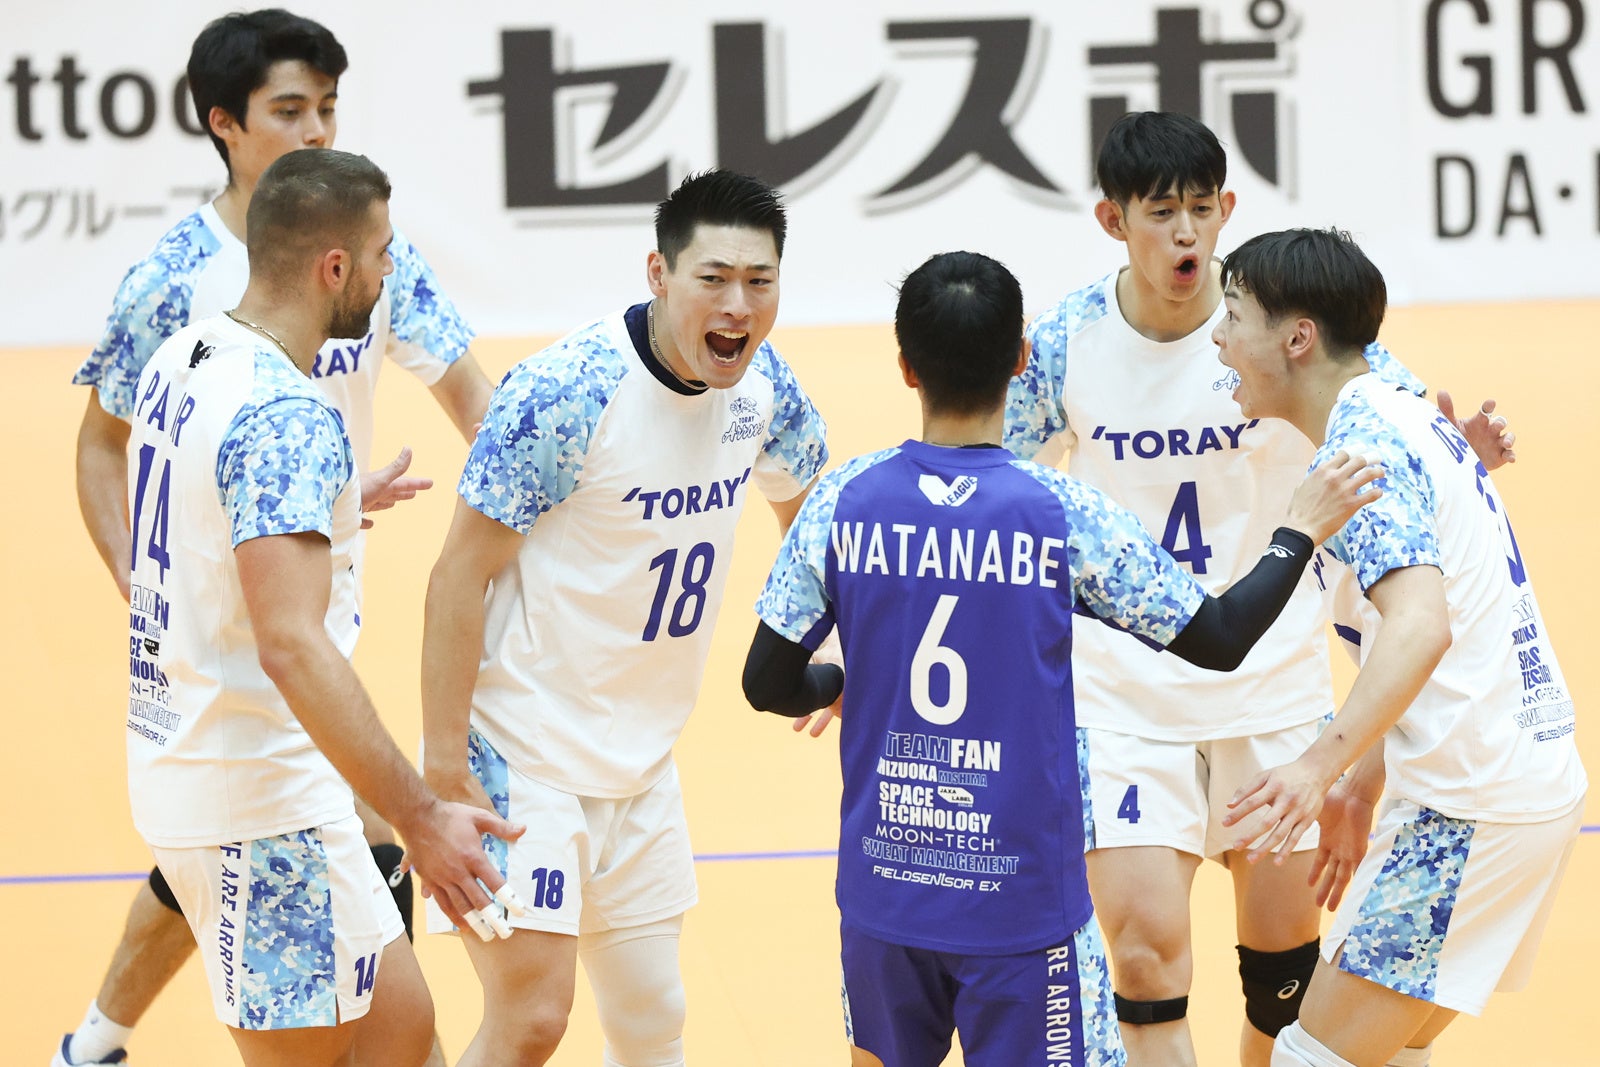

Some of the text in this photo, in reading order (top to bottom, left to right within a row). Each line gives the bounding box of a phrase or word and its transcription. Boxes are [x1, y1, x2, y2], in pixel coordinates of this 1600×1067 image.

[1425, 0, 1587, 117] GR
[467, 0, 1290, 212] セレスポ
[131, 443, 171, 585] 14
[941, 476, 978, 507] LEAGUE
[1160, 481, 1213, 574] 4
[831, 521, 1064, 588] WATANABE
[642, 541, 715, 642] 18
[910, 594, 968, 726] 6
[879, 781, 934, 807] SPACE
[938, 770, 987, 787] MISHIMA
[879, 801, 991, 834] TECHNOLOGY
[1117, 784, 1141, 824] 4
[862, 836, 1019, 874] SWEAT MANAGEMENT
[221, 864, 240, 911] ARE
[531, 867, 565, 910] 18
[979, 880, 1002, 892] EX
[354, 952, 376, 997] 14
